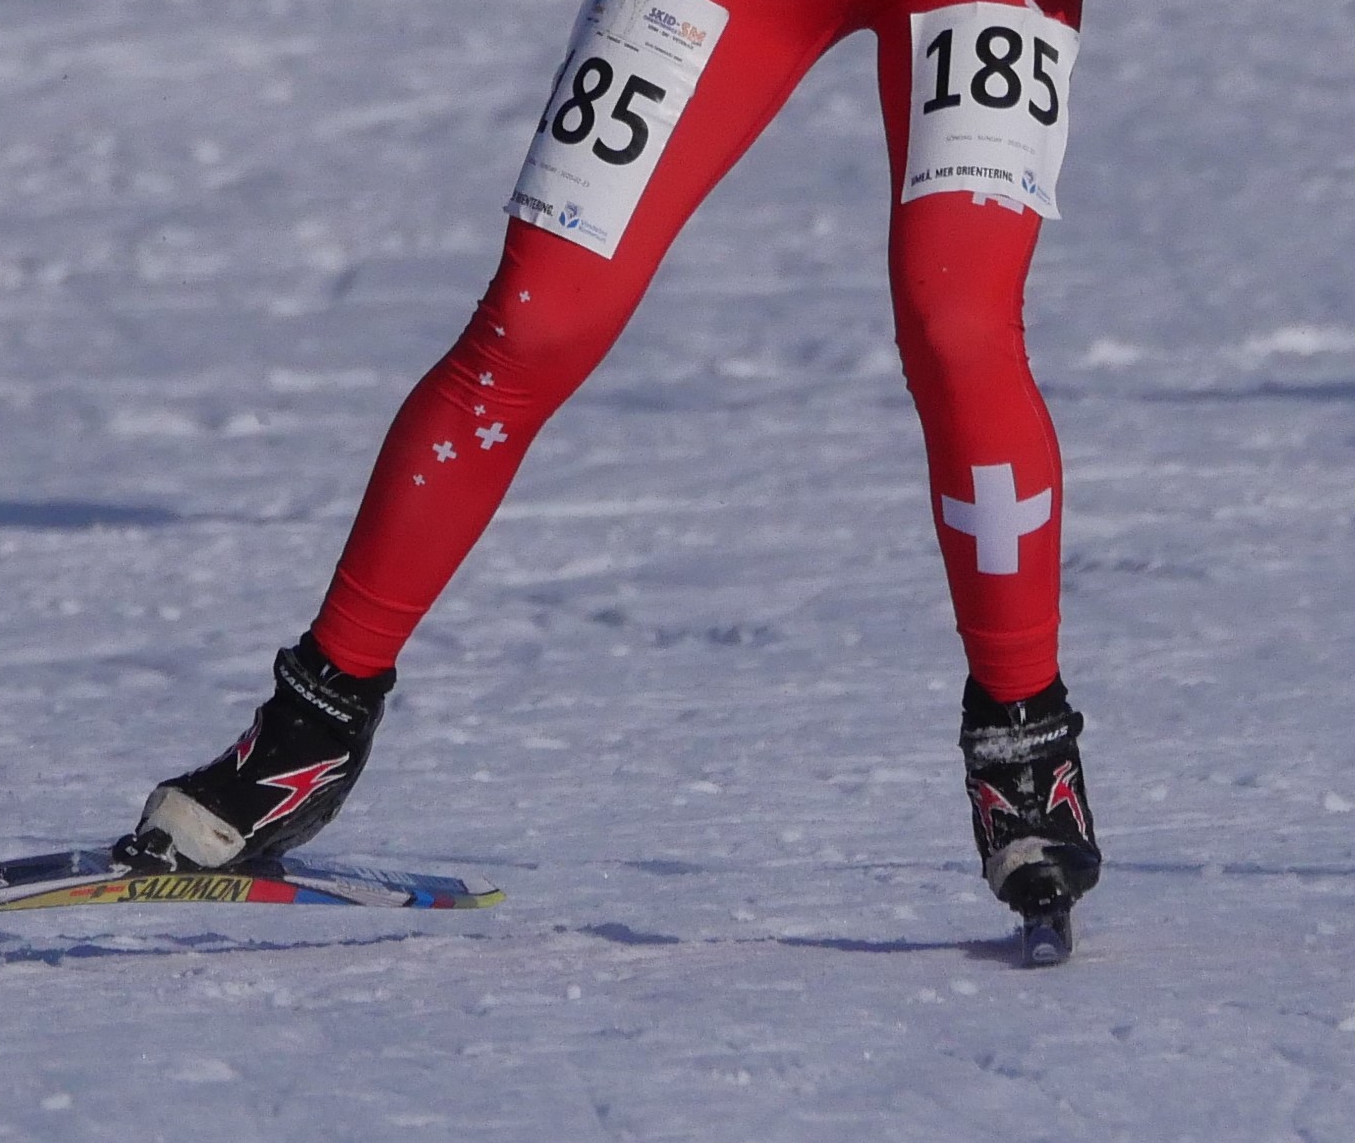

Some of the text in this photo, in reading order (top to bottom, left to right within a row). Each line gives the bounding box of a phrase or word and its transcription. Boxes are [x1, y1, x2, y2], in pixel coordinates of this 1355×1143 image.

[537, 49, 667, 167] 85
[923, 25, 1059, 127] 185
[935, 166, 954, 179] MER
[117, 876, 251, 903] SALOMON
